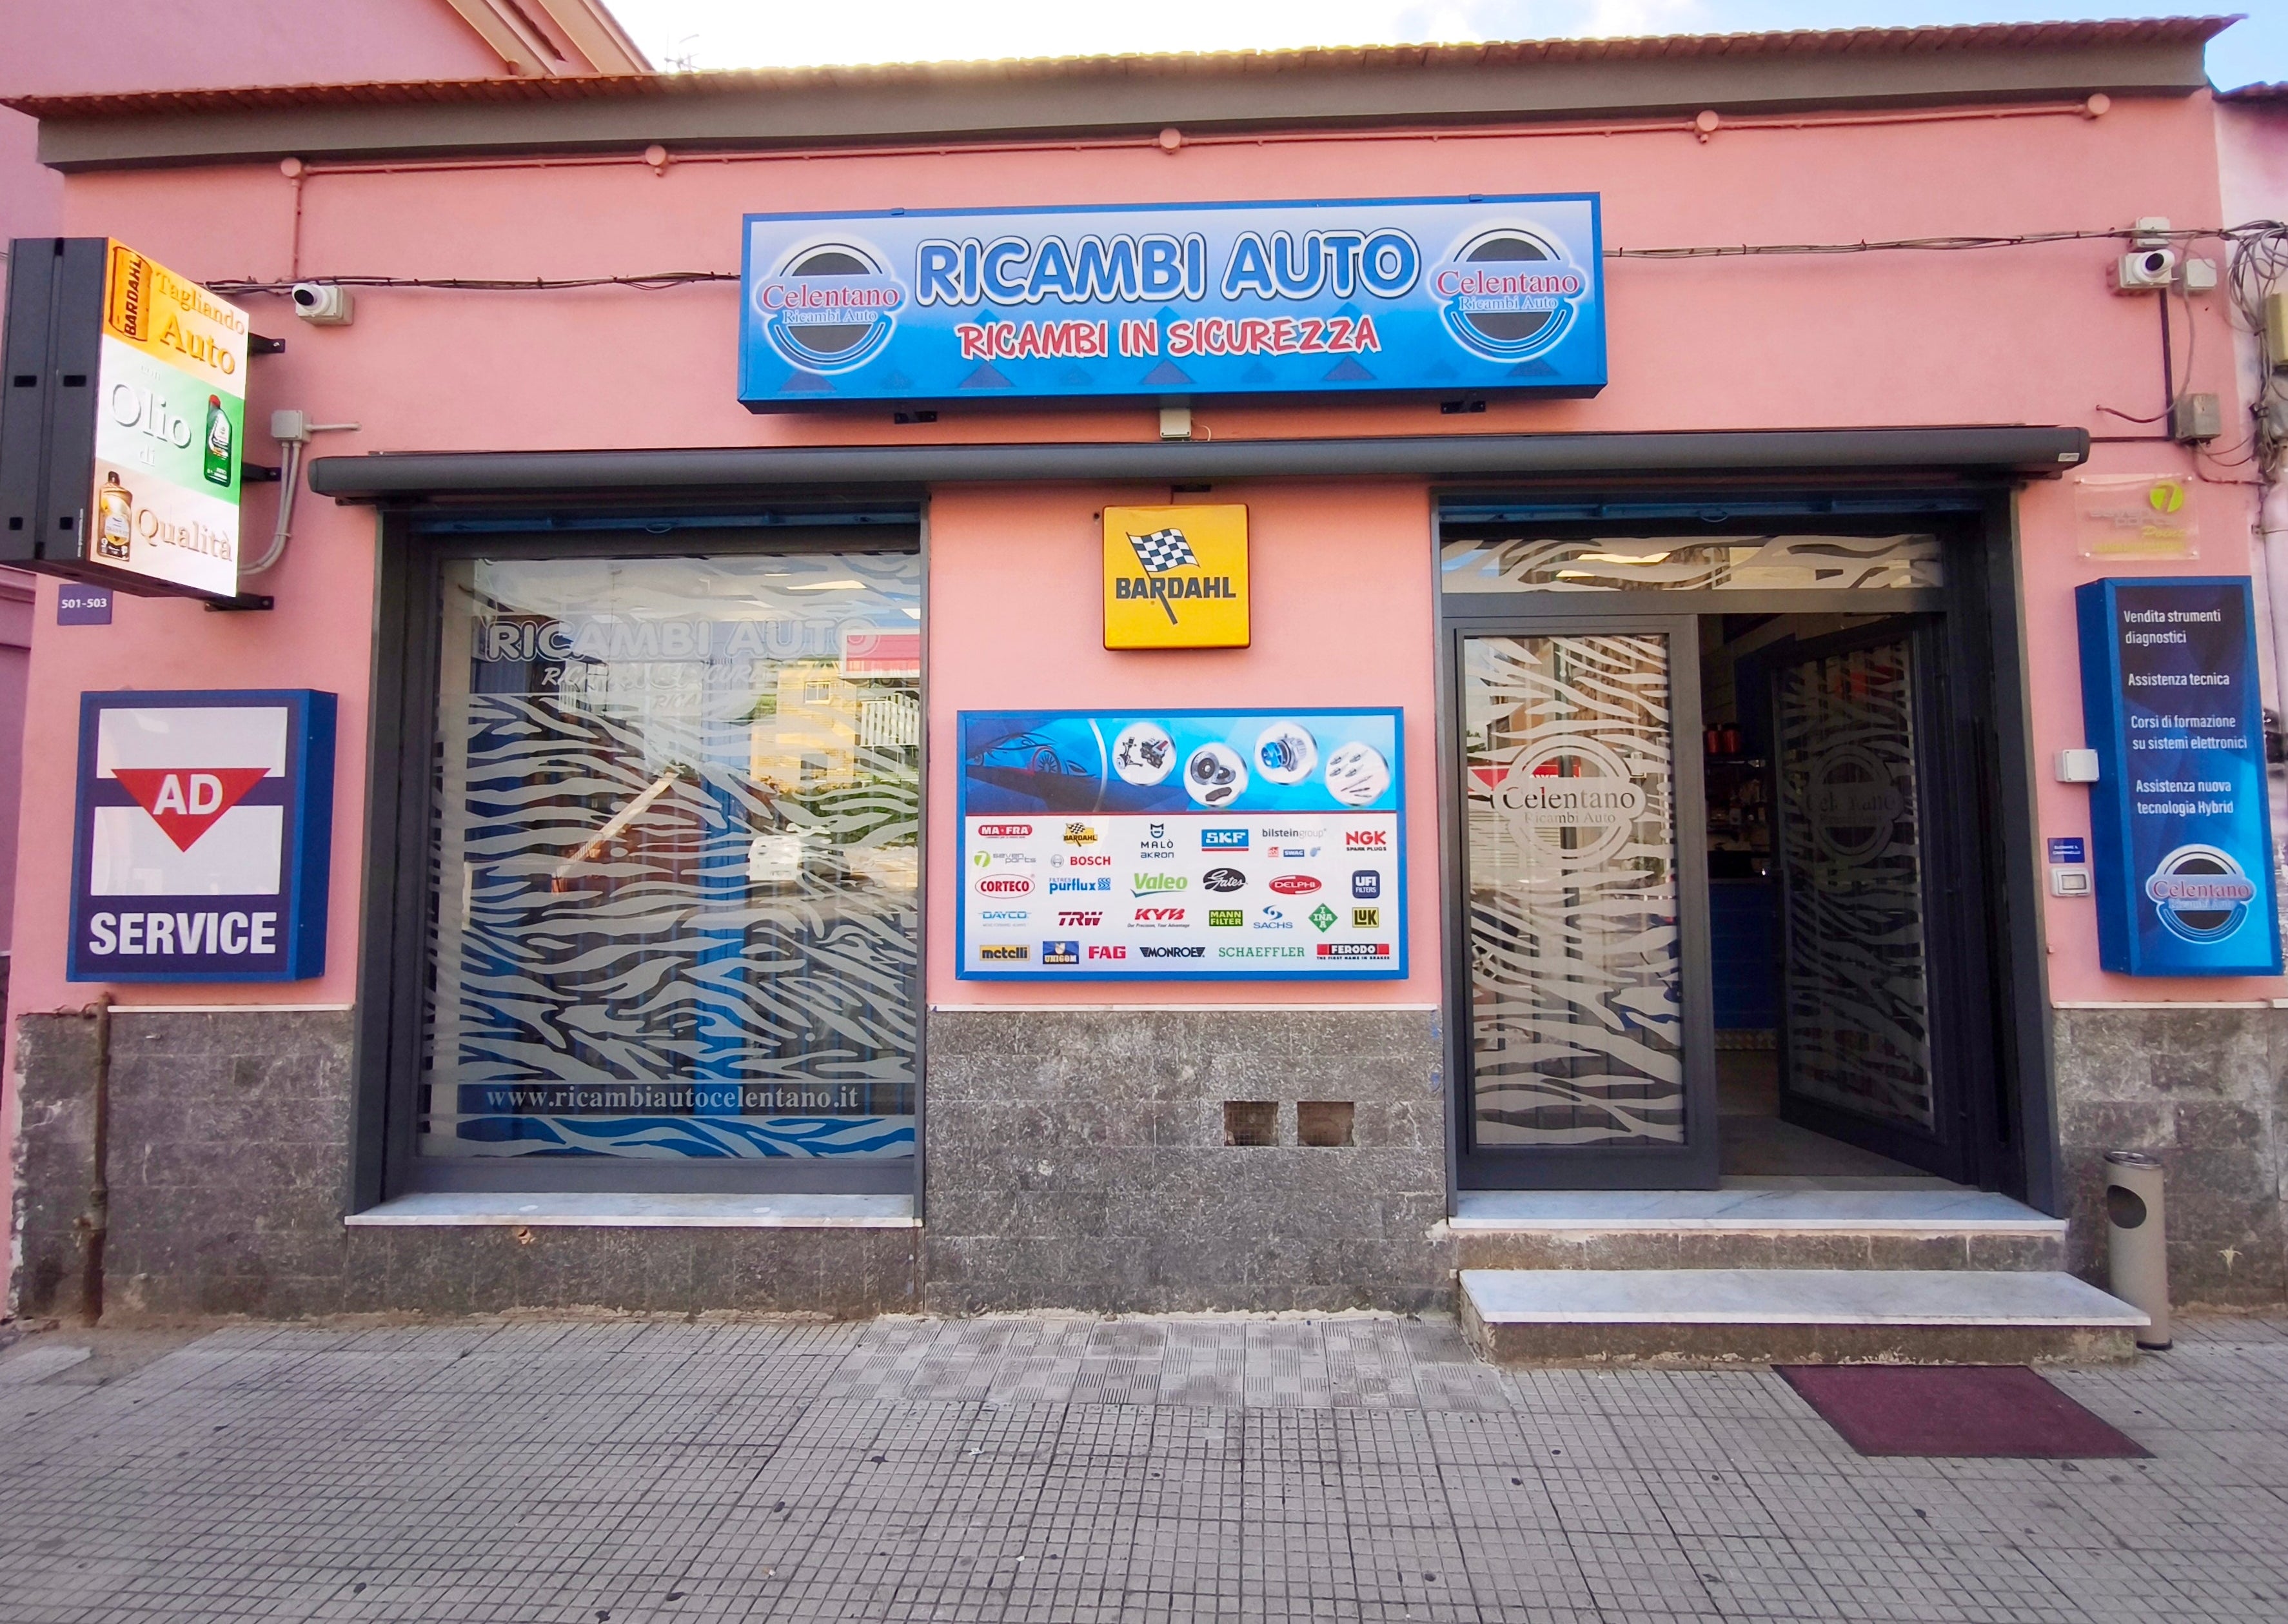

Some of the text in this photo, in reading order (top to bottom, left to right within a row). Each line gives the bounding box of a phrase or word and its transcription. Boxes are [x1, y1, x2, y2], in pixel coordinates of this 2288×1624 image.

[916, 228, 1422, 306] RICAMBI AUTO
[1437, 270, 1579, 296] Celentano
[123, 259, 142, 336] BARDAHL
[156, 271, 245, 335] Tagliando
[762, 284, 899, 310] Celentano
[1459, 296, 1557, 310] Ricambi Auto
[783, 309, 878, 323] Ricambi Auto
[160, 313, 235, 375] Auto
[957, 315, 1381, 360] RICAMBI IN SICUREZZA
[111, 384, 192, 449] Olio
[139, 447, 156, 467] di
[137, 507, 233, 563] Qualità
[1116, 576, 1237, 600] BARDAHL
[61, 598, 108, 609] 501-503
[2124, 609, 2222, 623] Vendita strumenti
[485, 616, 881, 662] RICAMBI AUTO
[2125, 630, 2187, 647] diagnostici
[2128, 672, 2231, 686] Assistenza tecnica
[2131, 714, 2236, 729] Corsi di formazione
[2133, 735, 2248, 749] su sistemi elettronici
[2136, 779, 2232, 793] Assistenza nuova
[153, 774, 224, 816] AD
[1503, 786, 1635, 809] Celentano
[2137, 800, 2234, 817] tecnologia Hybrid
[1583, 812, 1616, 823] Auto
[1141, 838, 1174, 848] MALÒ
[1205, 832, 1246, 844] SKF
[1346, 830, 1386, 845] NGK
[1070, 856, 1111, 866] BOSCH
[980, 881, 1030, 892] CORTECO
[1049, 879, 1096, 895] purflux
[1134, 873, 1188, 890] Valeo
[1205, 870, 1246, 890] Gates
[1356, 876, 1376, 886] UFI
[2153, 880, 2249, 897] Celentano
[982, 911, 1027, 919] DAYCO
[1058, 912, 1103, 926] TRW
[1135, 908, 1185, 921] KYB
[89, 911, 277, 955] SERVICE
[981, 946, 1028, 959] metelli
[1088, 946, 1126, 959] FAG
[1147, 946, 1199, 958] MONROE
[1218, 946, 1305, 957] SCHAEFFLER
[1330, 944, 1376, 954] FERODO
[487, 1085, 858, 1109] www.ricambiautocelentano.it
